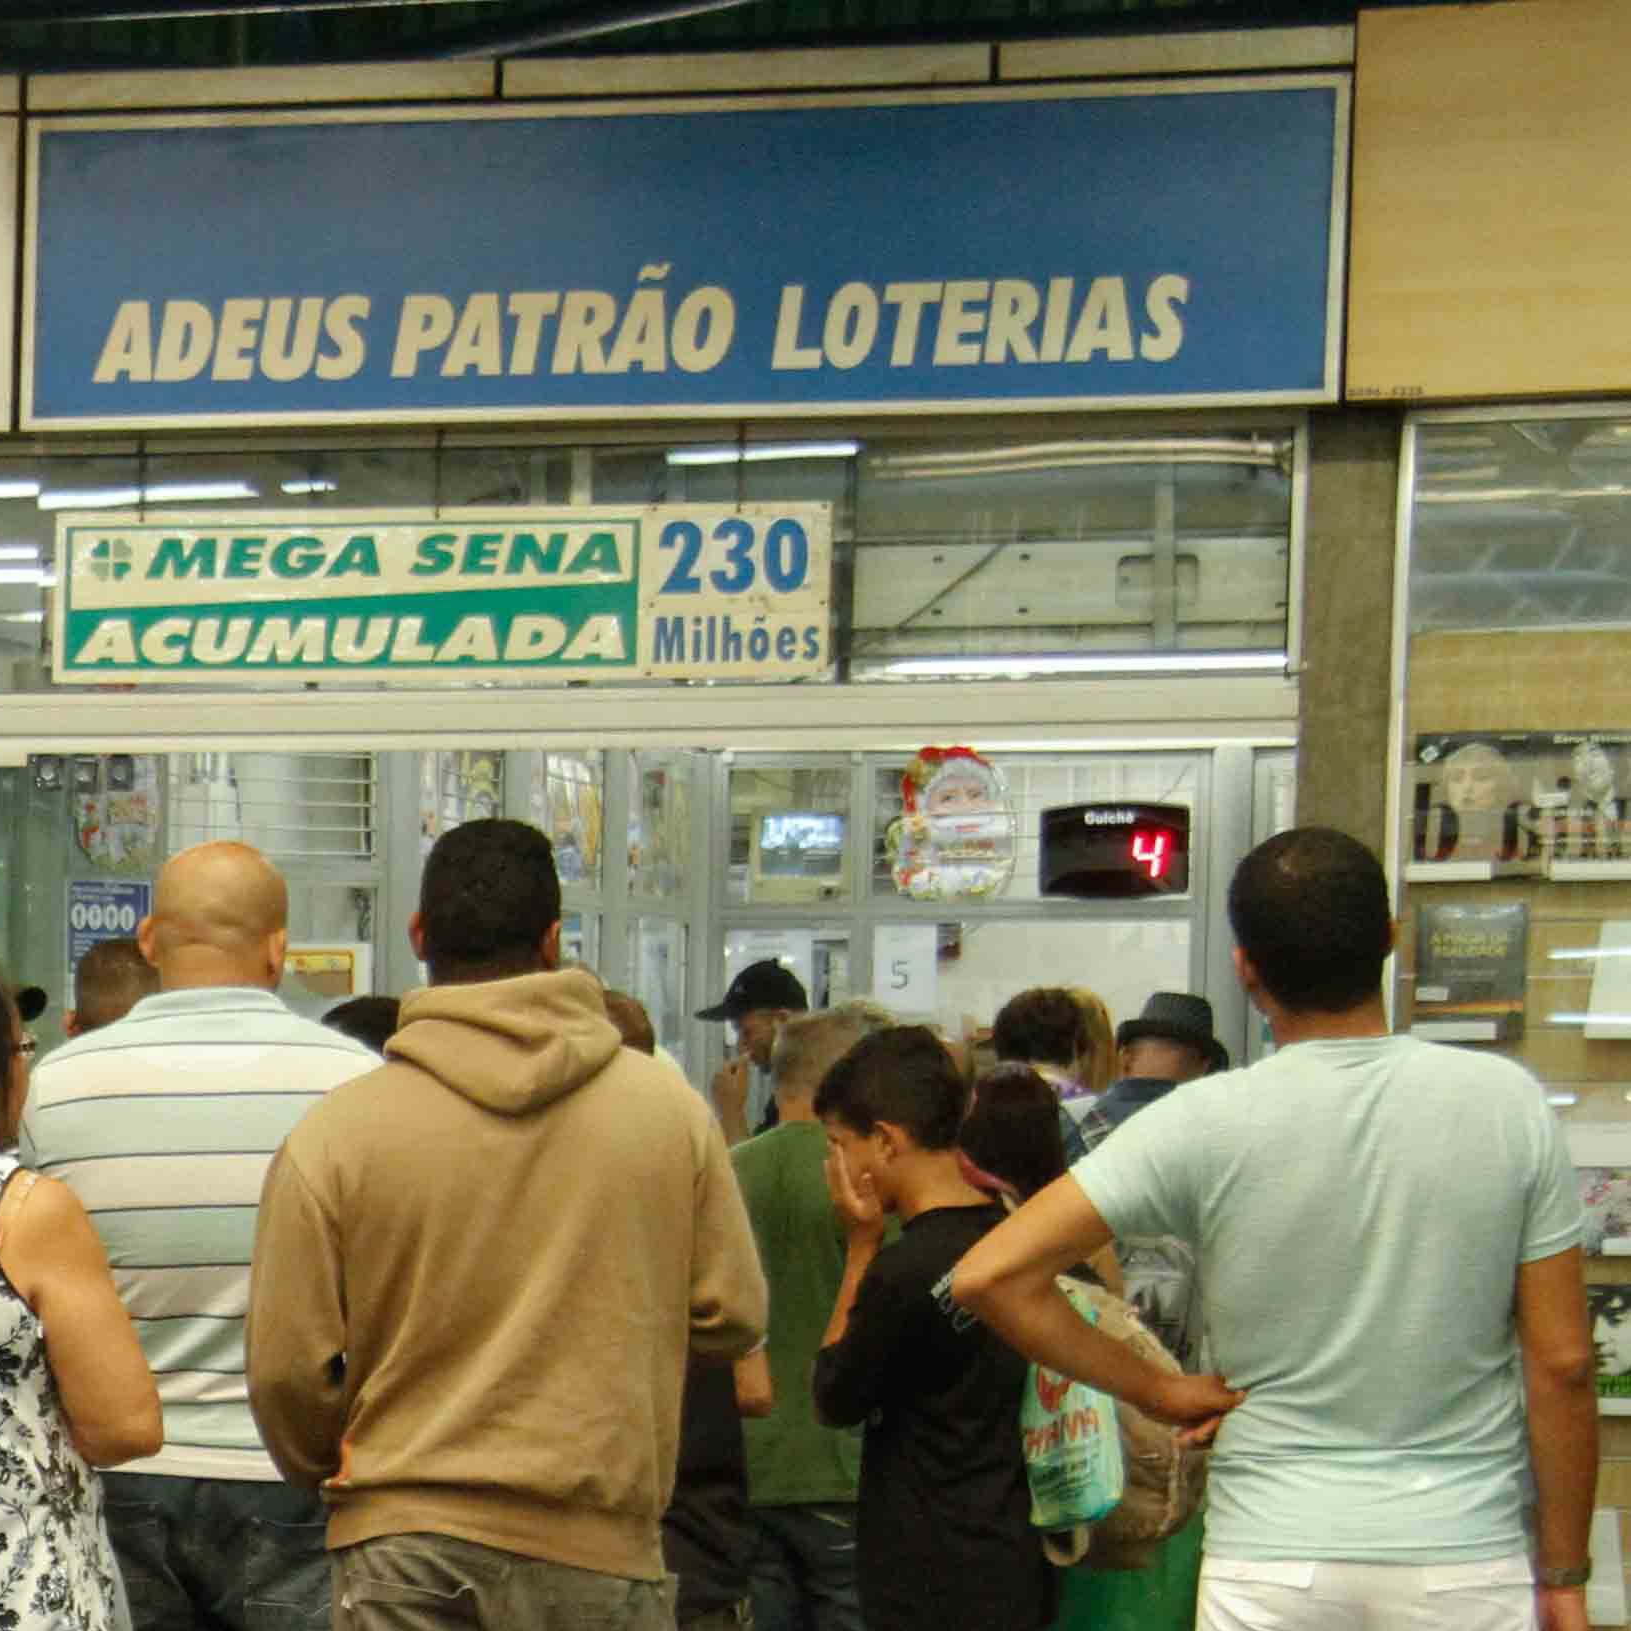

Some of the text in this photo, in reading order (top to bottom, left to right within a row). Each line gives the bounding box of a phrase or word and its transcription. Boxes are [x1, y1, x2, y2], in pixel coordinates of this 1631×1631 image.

[91, 260, 1191, 384] ADEUS PATRÃO LOTERIAS
[144, 531, 624, 581] MEGA SENA
[658, 517, 810, 595] 230
[72, 613, 628, 667] ACUMULADA
[652, 615, 822, 666] Milhões
[1132, 835, 1166, 878] 4
[890, 958, 910, 990] 5
